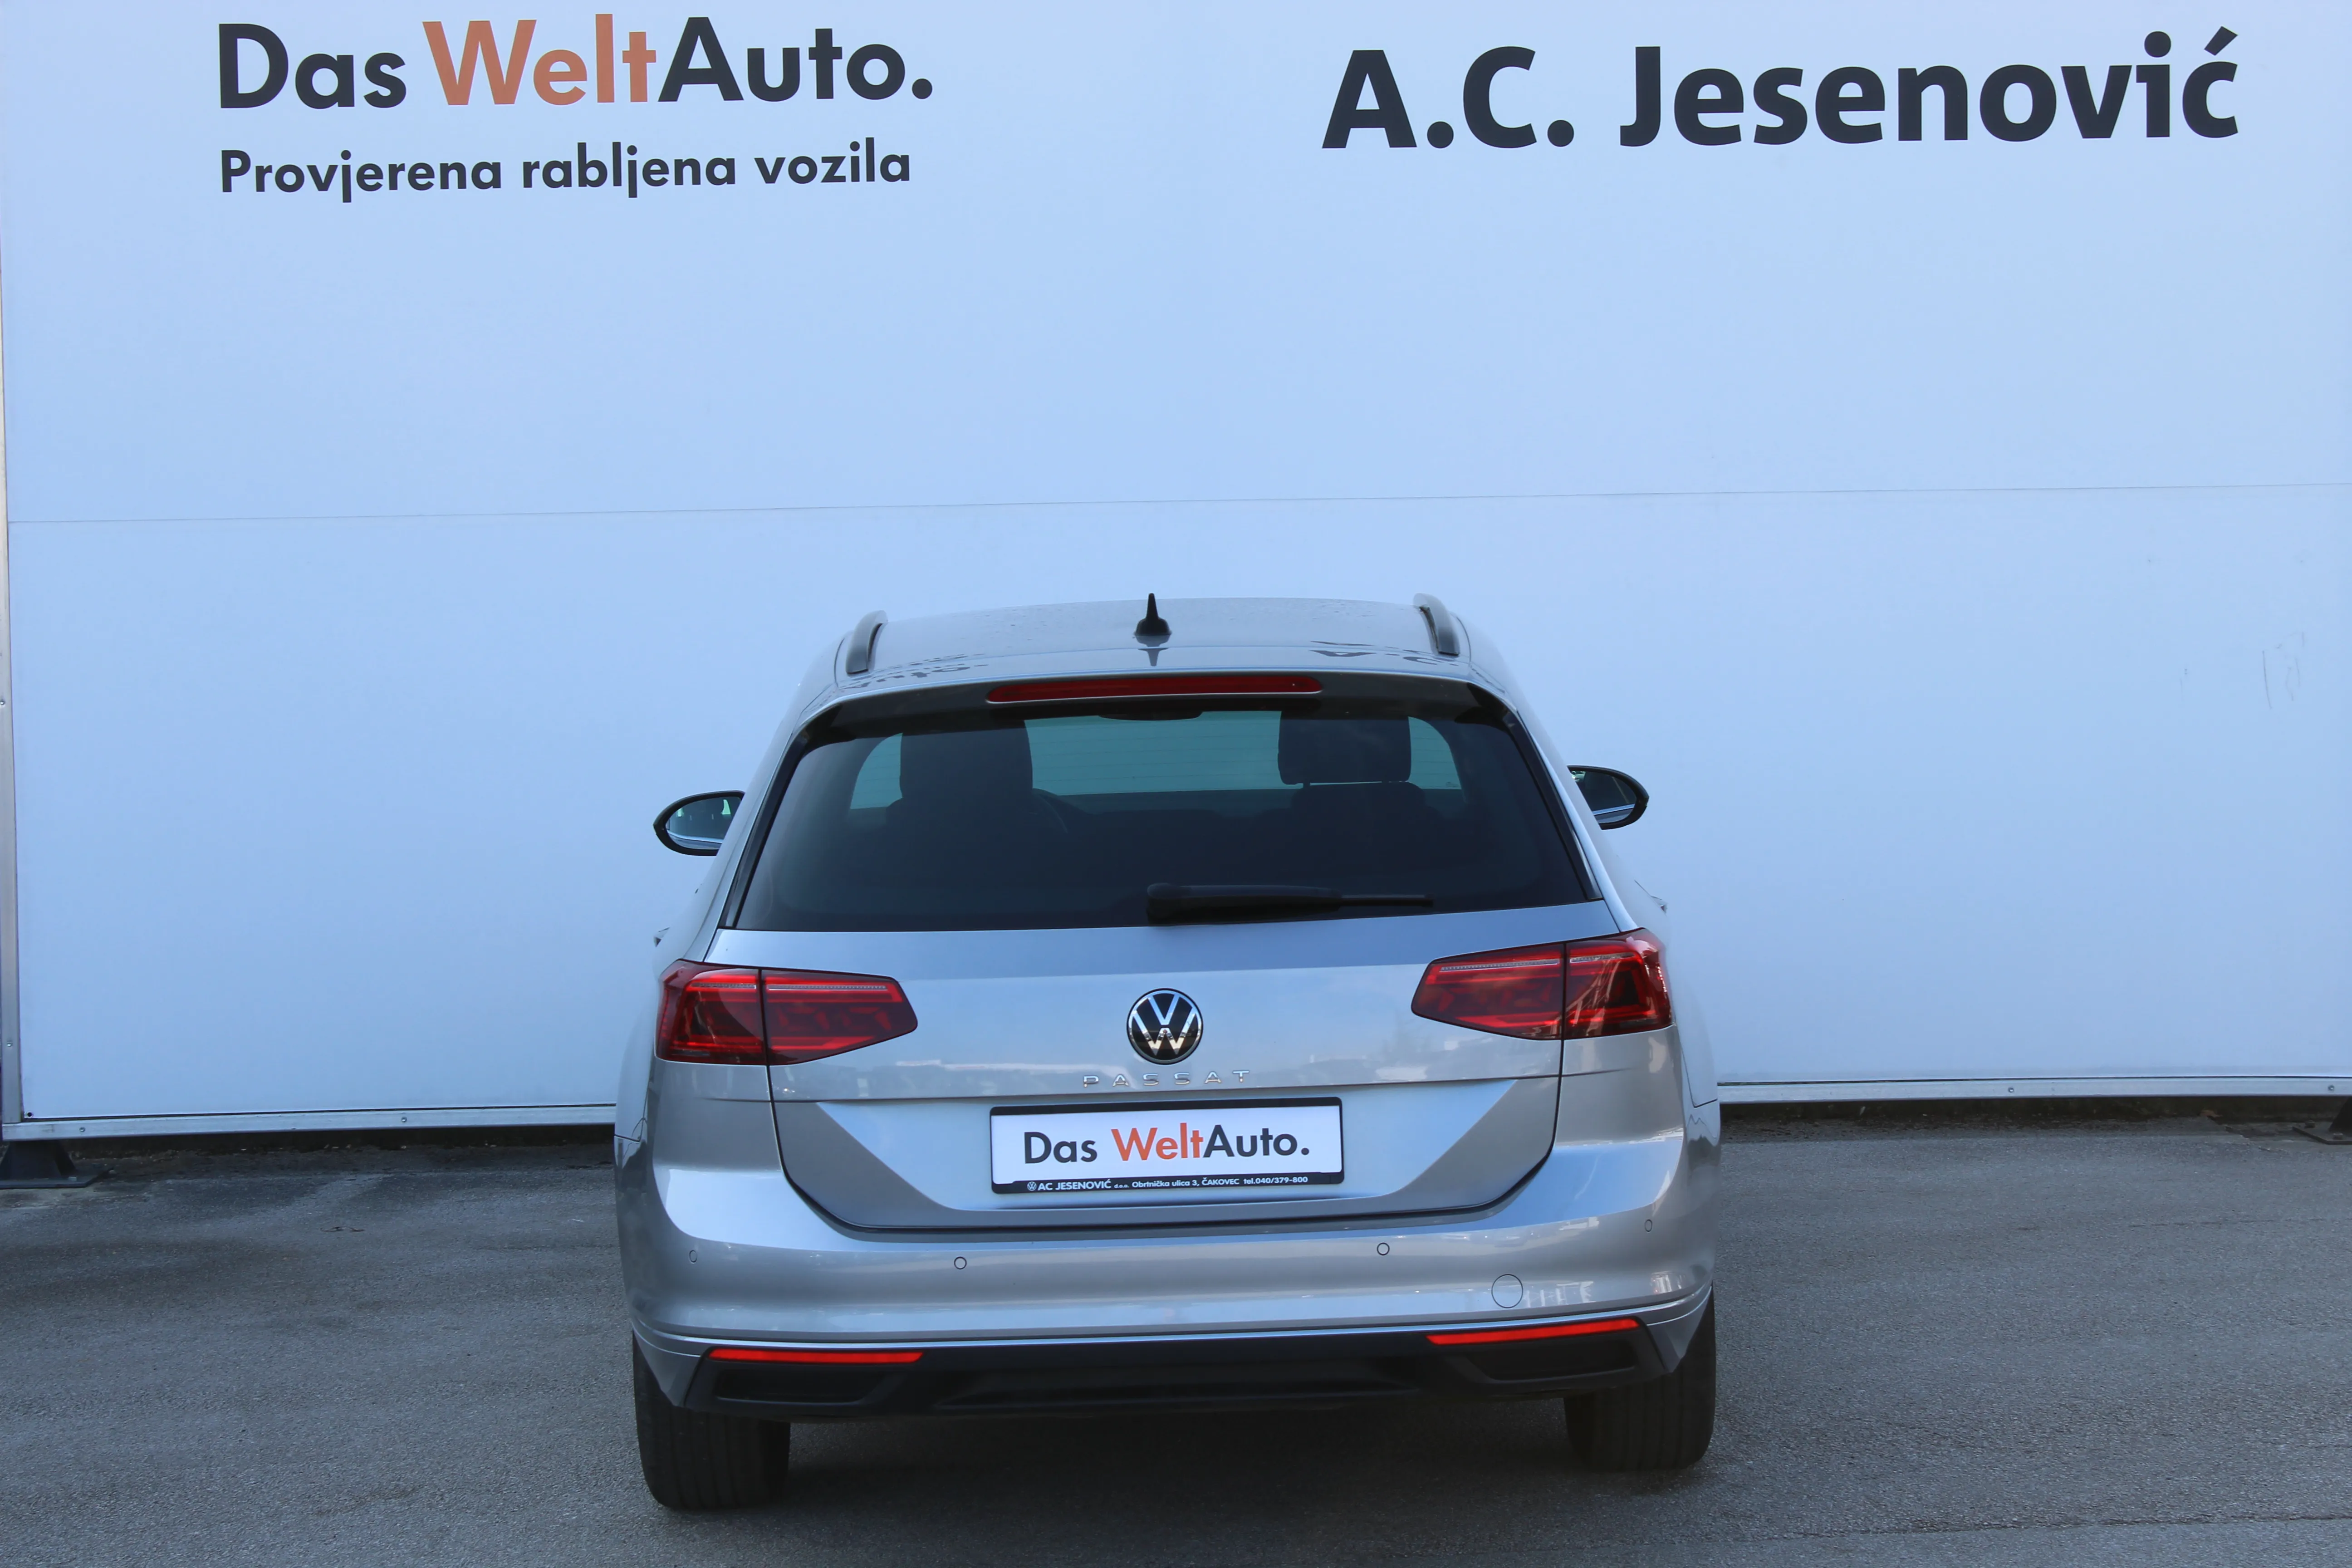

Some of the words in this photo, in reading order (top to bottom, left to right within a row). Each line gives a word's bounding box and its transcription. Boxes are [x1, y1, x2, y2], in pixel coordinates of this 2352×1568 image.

[219, 24, 406, 109] Das
[422, 14, 932, 105] WeltAuto.
[1322, 46, 1574, 149] A.C.
[1620, 26, 2238, 147] Jesenović
[221, 150, 501, 203] Provjerena
[523, 142, 735, 198] rabljena
[754, 137, 910, 184] vozila
[1083, 1070, 1250, 1088] PASSAT
[1024, 1132, 1097, 1164] Das
[1112, 1123, 1309, 1161] WeltAuto.
[1038, 1182, 1053, 1191] AC
[1055, 1179, 1112, 1191] JESENOVIĆ
[1201, 1177, 1240, 1186] ČAKOVEC
[1243, 1176, 1308, 1185] tel.040/379-800
